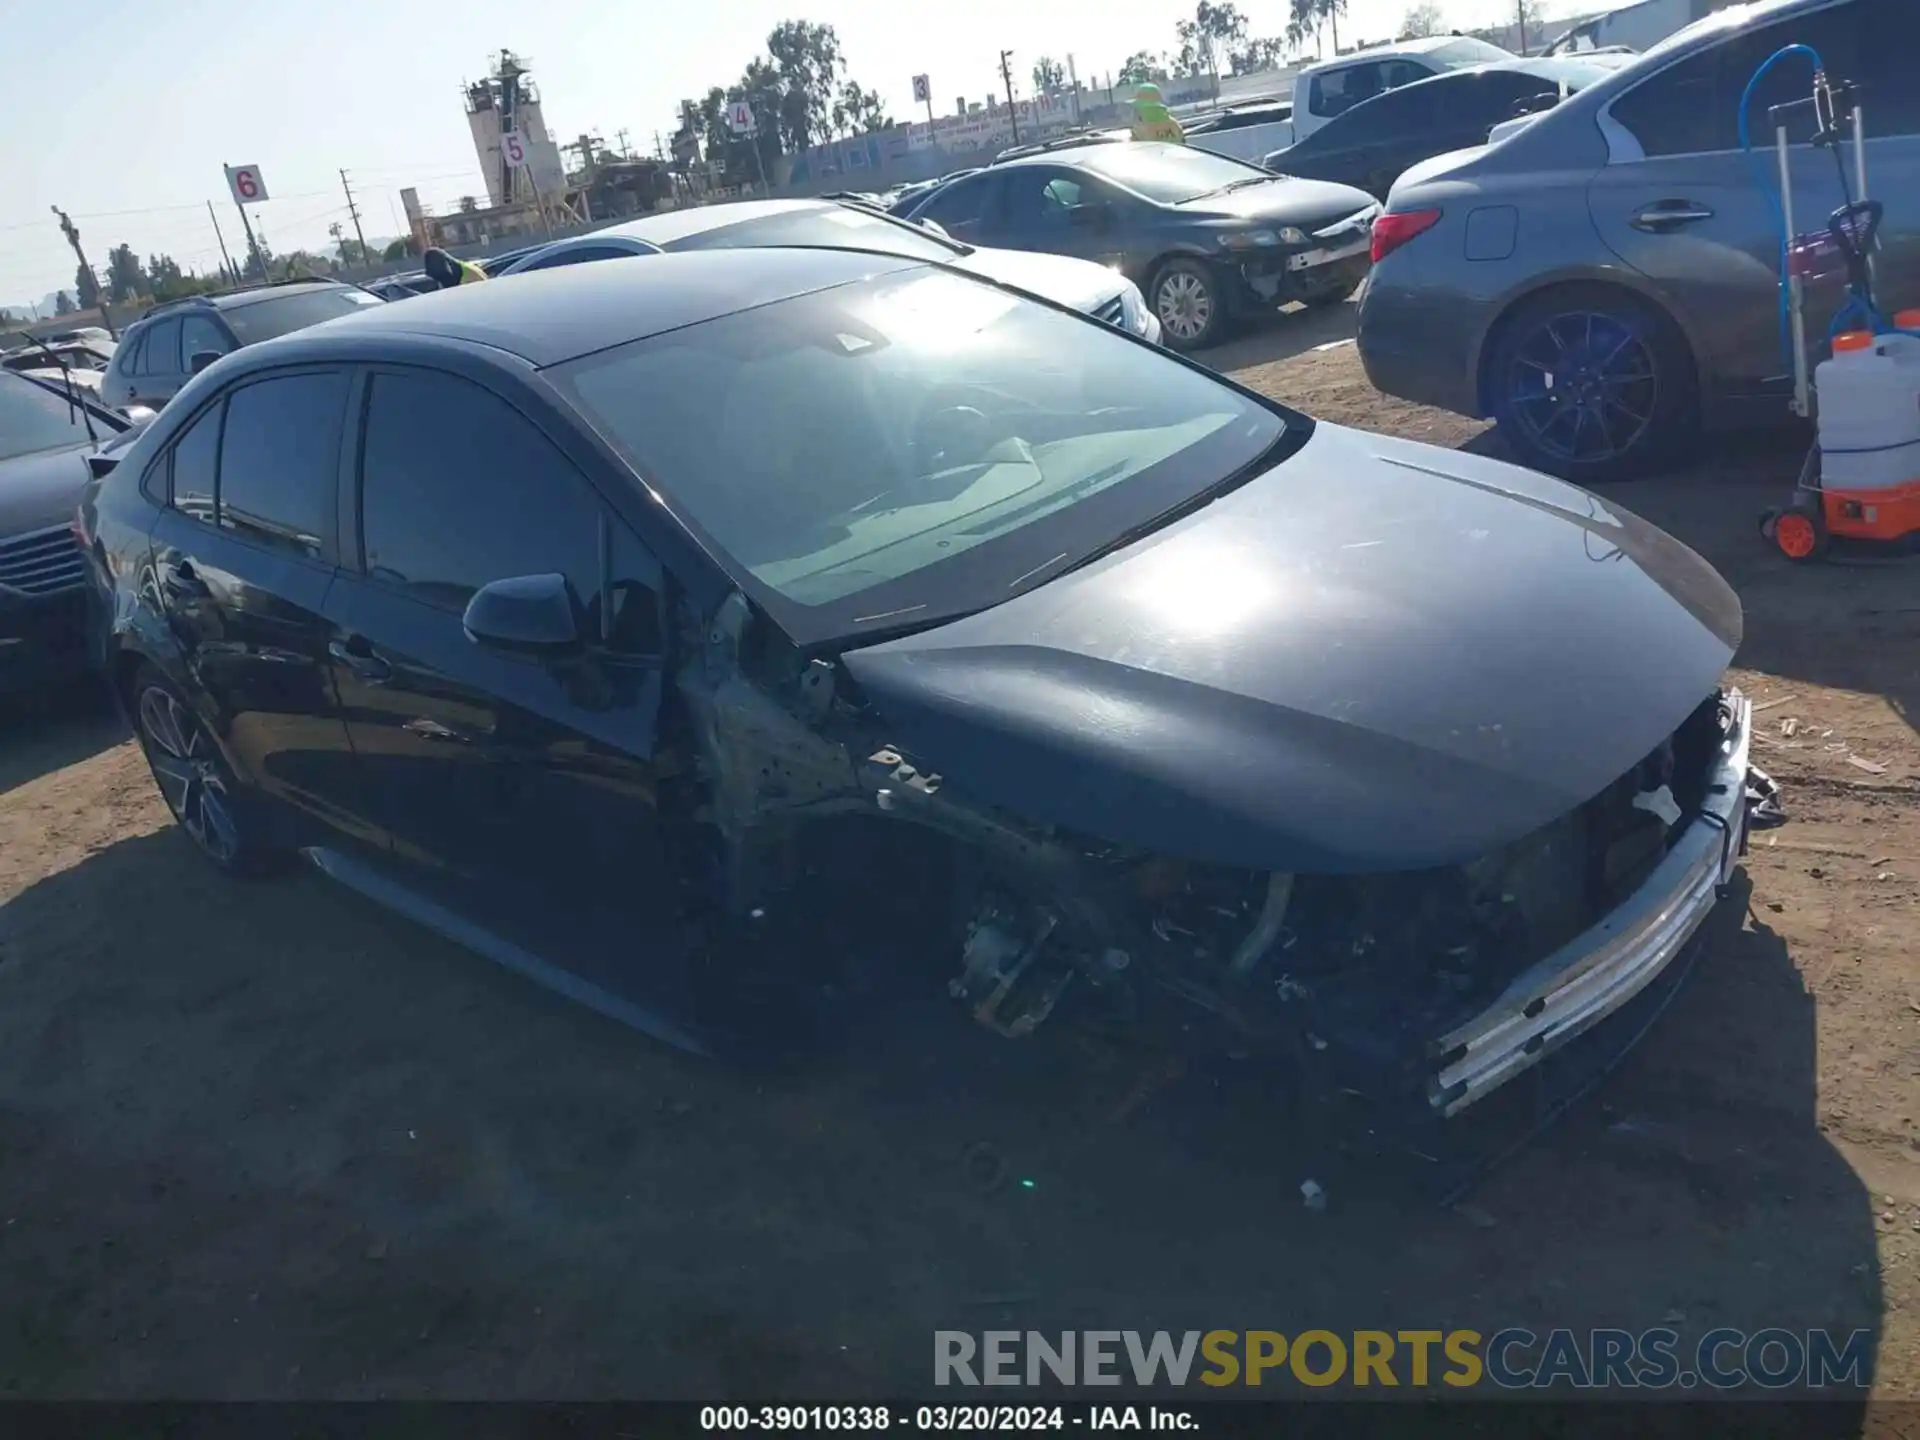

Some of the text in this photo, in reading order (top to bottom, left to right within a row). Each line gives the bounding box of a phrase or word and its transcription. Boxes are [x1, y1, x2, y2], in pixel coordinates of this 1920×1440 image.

[916, 77, 927, 99] 3
[736, 105, 749, 128] 4
[507, 135, 524, 161] 5
[236, 170, 258, 198] 6
